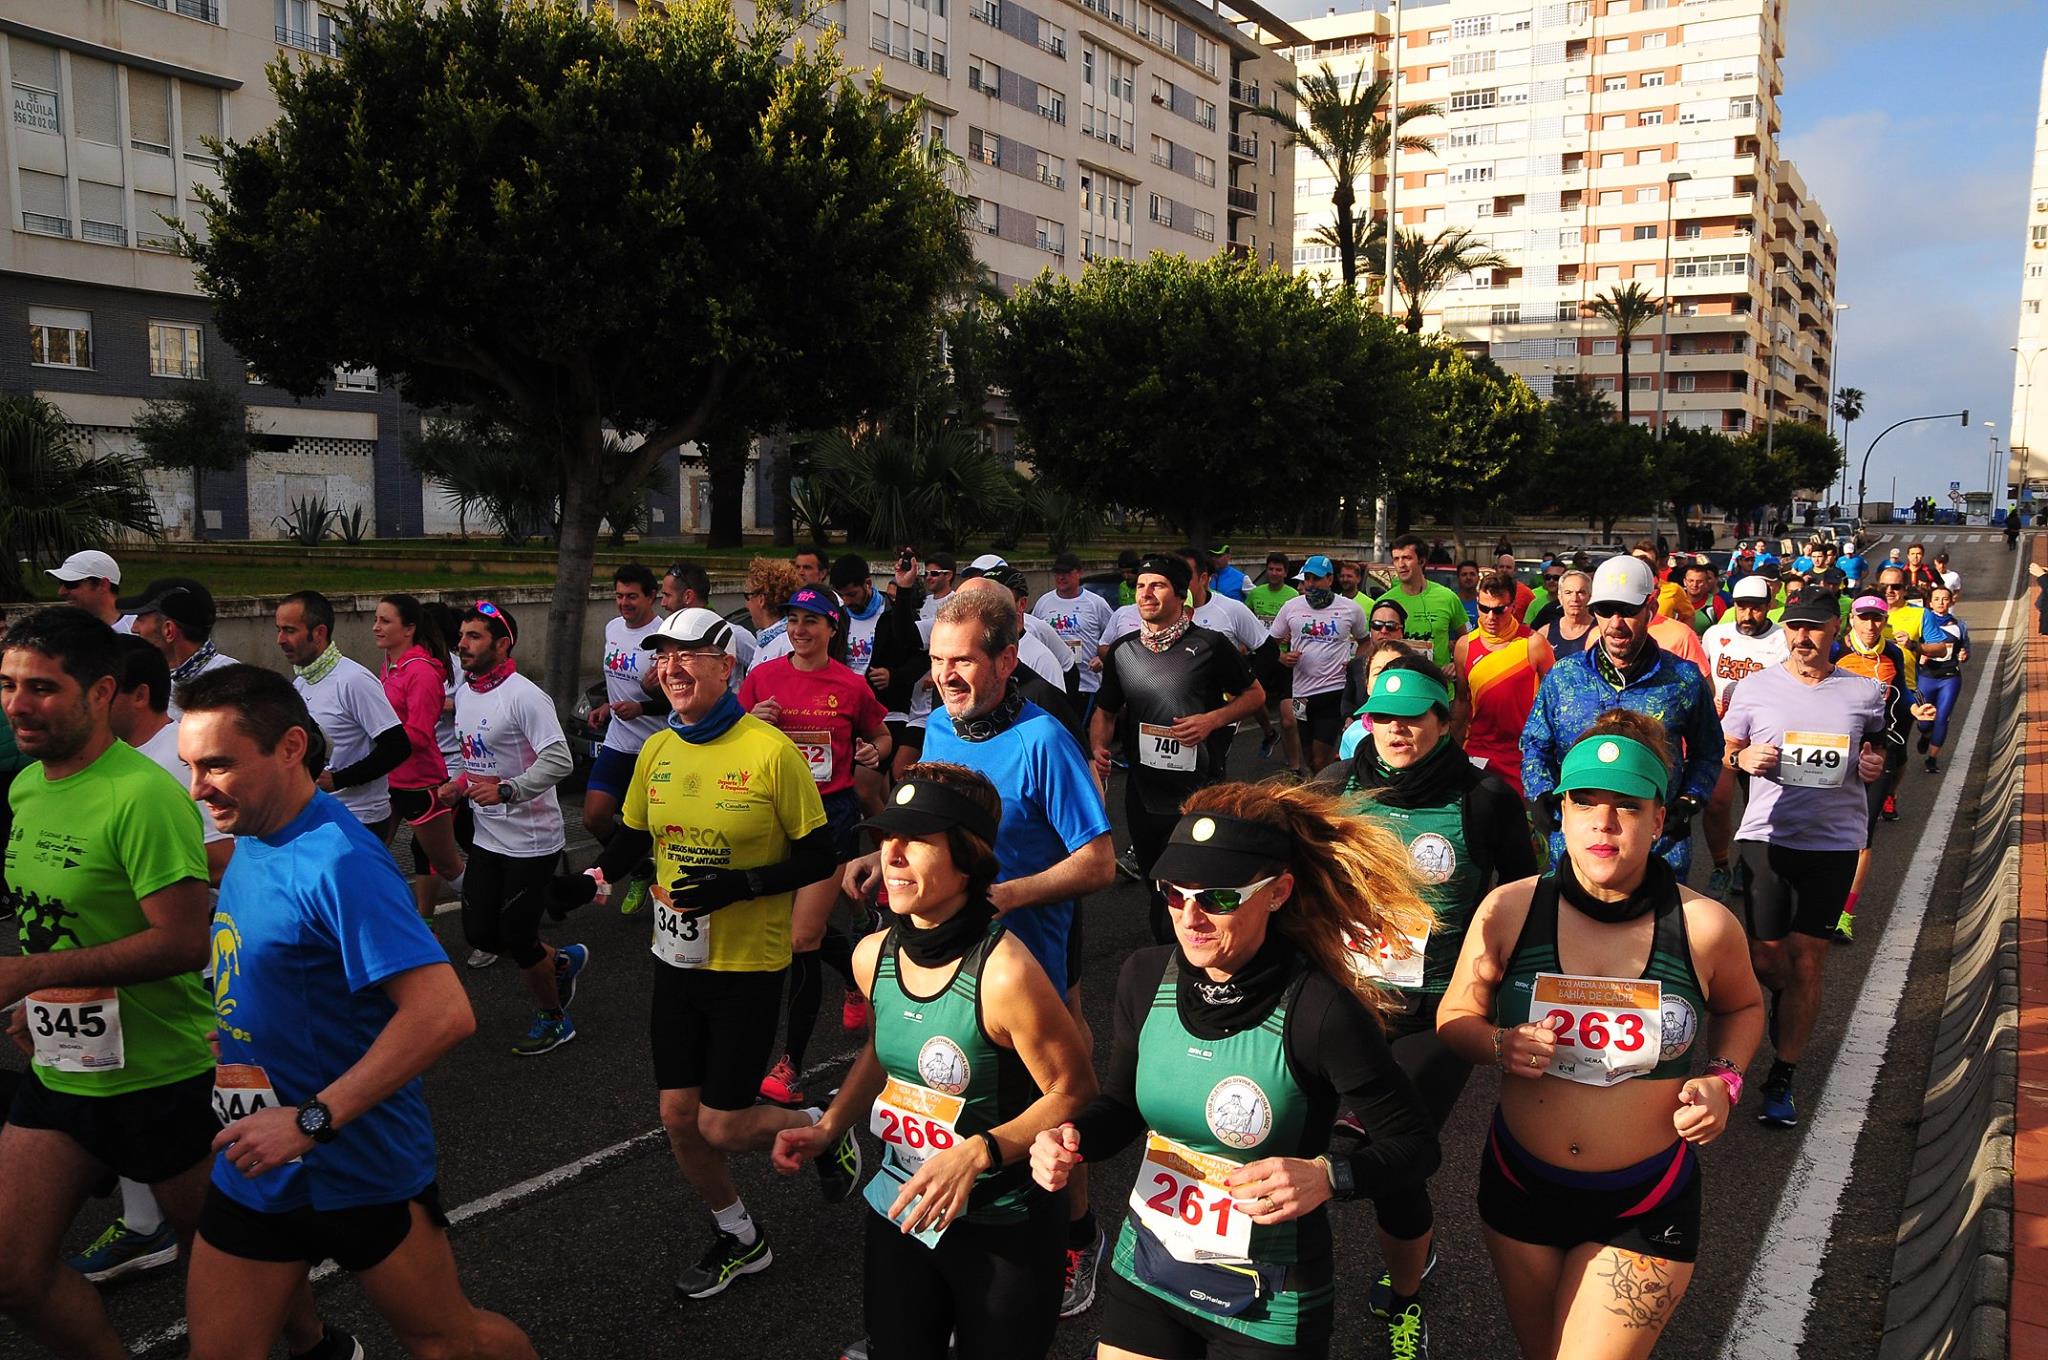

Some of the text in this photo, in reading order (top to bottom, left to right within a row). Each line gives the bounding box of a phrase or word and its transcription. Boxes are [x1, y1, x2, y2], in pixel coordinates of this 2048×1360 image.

[28, 93, 38, 103] SE
[15, 100, 54, 117] ALQUILA
[1154, 737, 1180, 755] 740
[1792, 748, 1841, 769] 149
[667, 843, 732, 856] JUEGOS NACIONALES
[675, 854, 731, 865] TRASPLANTADOS
[658, 906, 699, 942] 343
[1559, 987, 1635, 1002] BAHÍA DE CÁDIZ
[1573, 981, 1597, 990] MEDIA
[1598, 982, 1637, 992] MARATÓN
[33, 1005, 106, 1038] 345
[1546, 1008, 1645, 1052] 263
[879, 1109, 954, 1150] 266
[1145, 1172, 1233, 1237] 261
